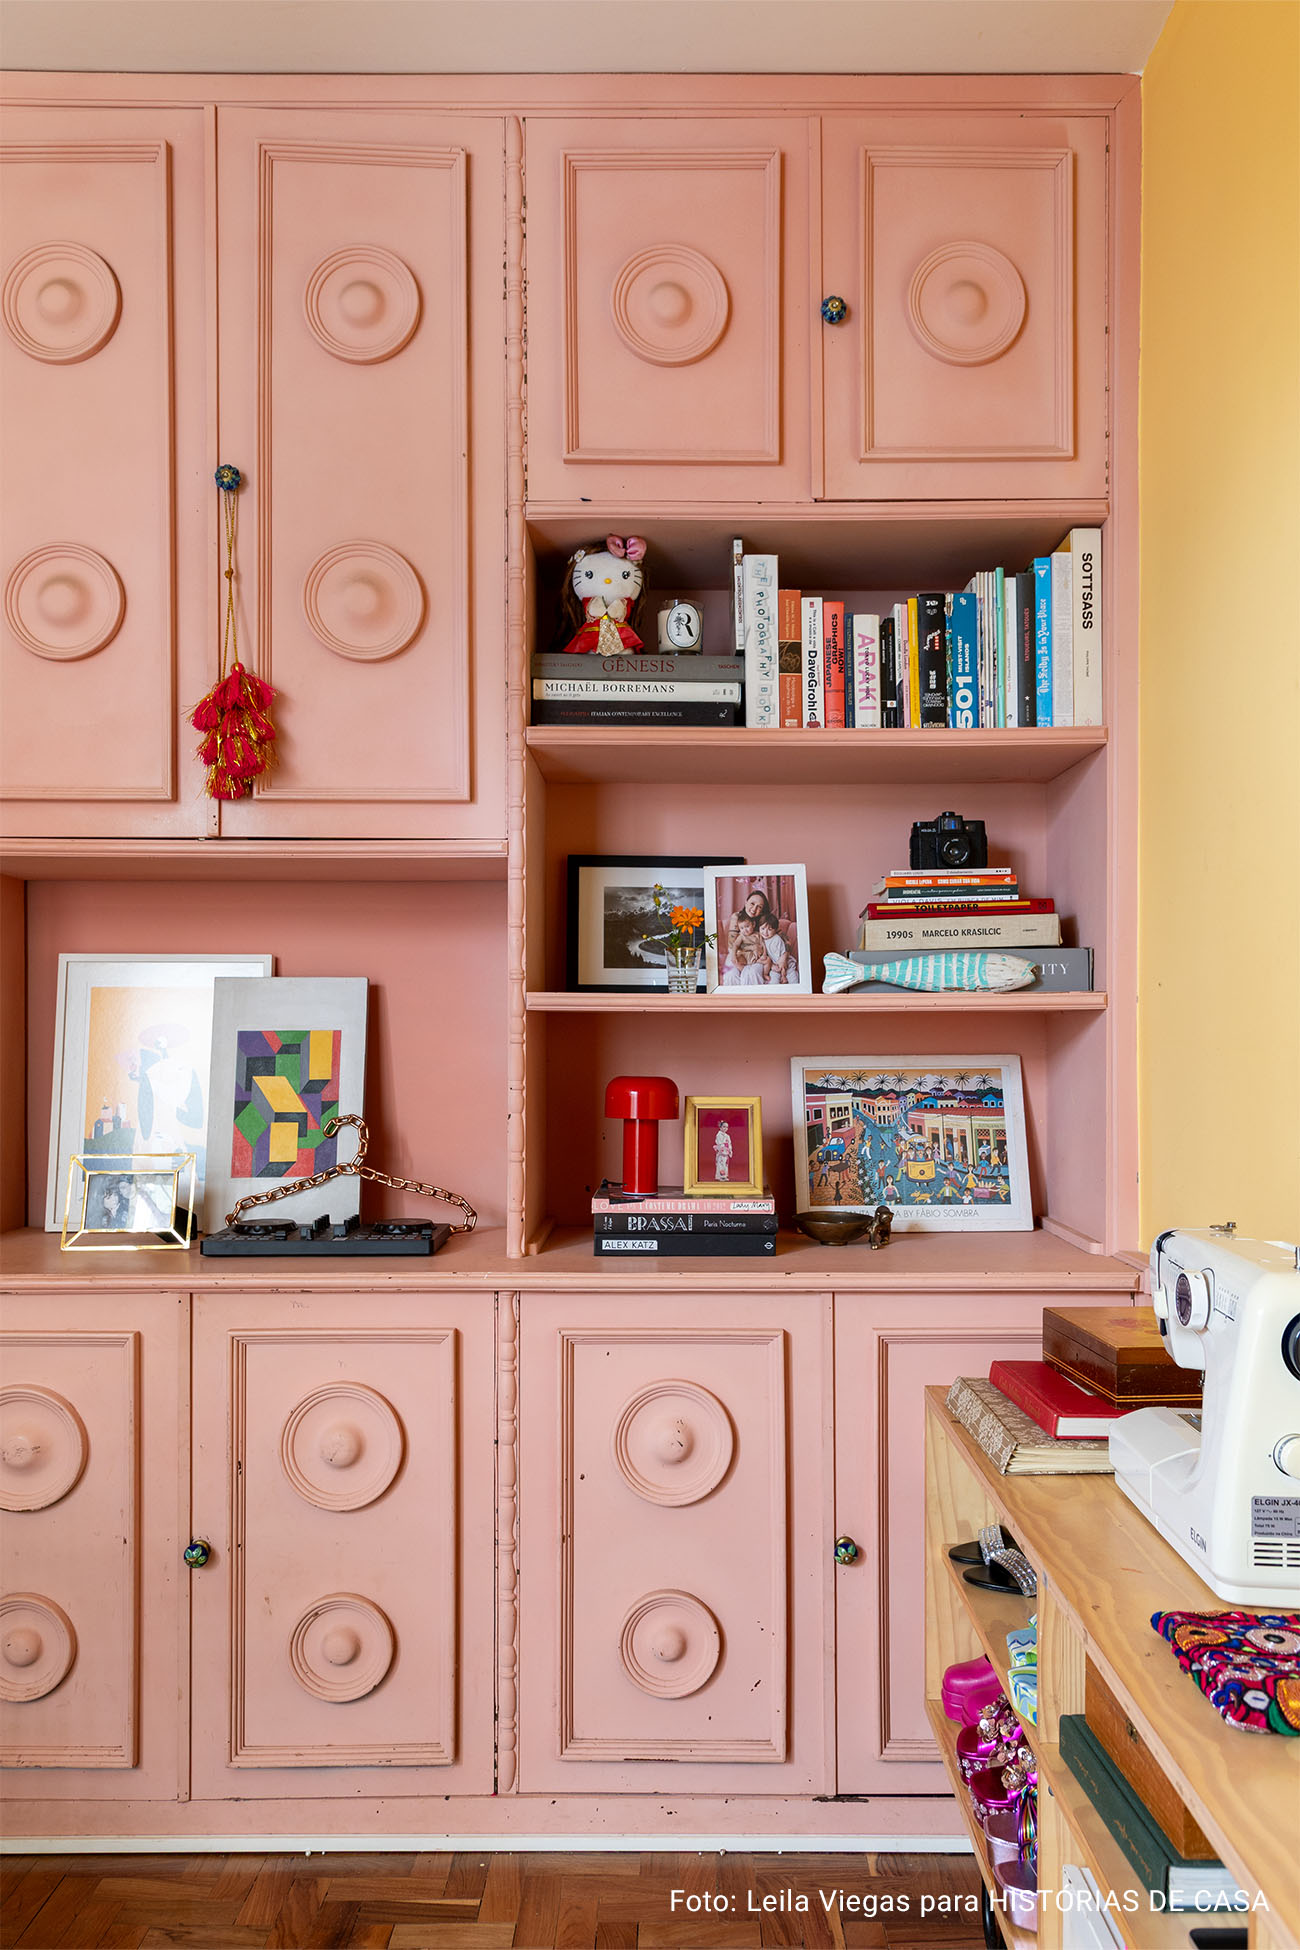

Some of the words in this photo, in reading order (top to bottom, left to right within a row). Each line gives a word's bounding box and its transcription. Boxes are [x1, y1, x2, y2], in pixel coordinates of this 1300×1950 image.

[754, 562, 768, 583] THE
[1081, 552, 1093, 630] SOTTSASS
[755, 591, 772, 678] PHOTOGRAPHY
[601, 656, 676, 673] GÊNESIS
[857, 632, 877, 711] ARAKI
[545, 682, 599, 692] MICHAËL
[602, 683, 676, 693] BORREMANS
[807, 650, 818, 712] DaveGrohl
[757, 686, 771, 722] BOOK
[955, 675, 974, 728] 501
[914, 903, 979, 912] TOILETPAPER
[886, 931, 913, 939] 1990s
[922, 929, 959, 937] MARCELO
[961, 927, 1002, 936] KRASILCIC
[1041, 963, 1069, 975] ITY
[903, 1209, 914, 1217] BY
[916, 1208, 940, 1217] FÁBIO
[943, 1209, 979, 1217] SOMBRA
[604, 1241, 629, 1249] ALEX
[631, 1241, 655, 1249] KATZ
[1254, 1498, 1279, 1506] ELGIN
[1190, 1527, 1207, 1552] ELGIN
